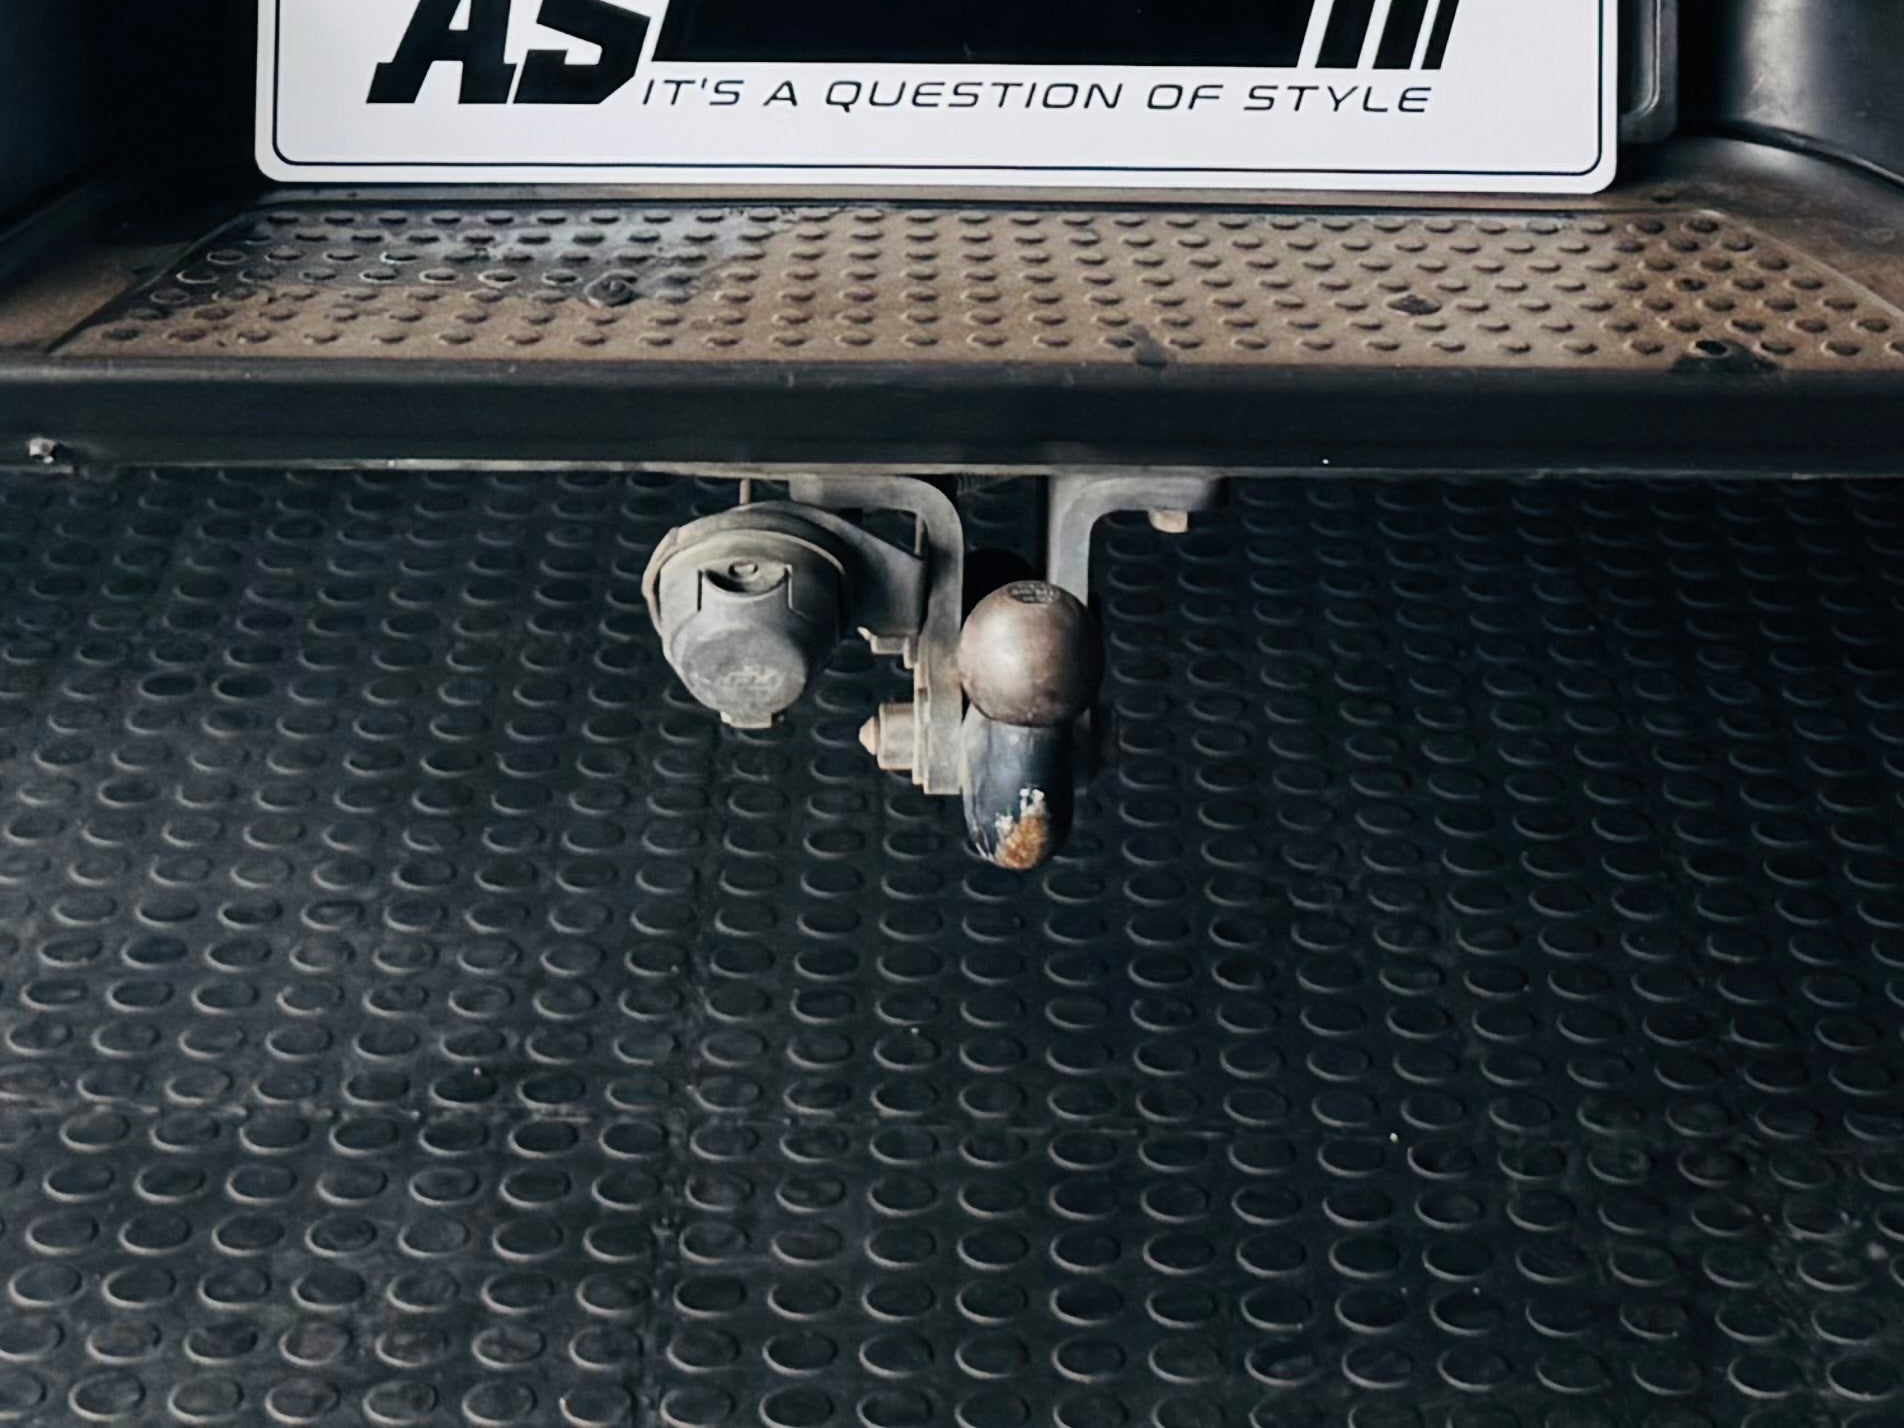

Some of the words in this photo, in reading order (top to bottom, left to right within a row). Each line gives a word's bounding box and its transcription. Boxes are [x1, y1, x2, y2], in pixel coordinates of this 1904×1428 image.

[642, 78, 745, 108] IT'S
[763, 80, 799, 108] A
[824, 80, 1124, 113] QUESTION
[1146, 83, 1225, 111] OF
[1243, 84, 1433, 114] STYLE
